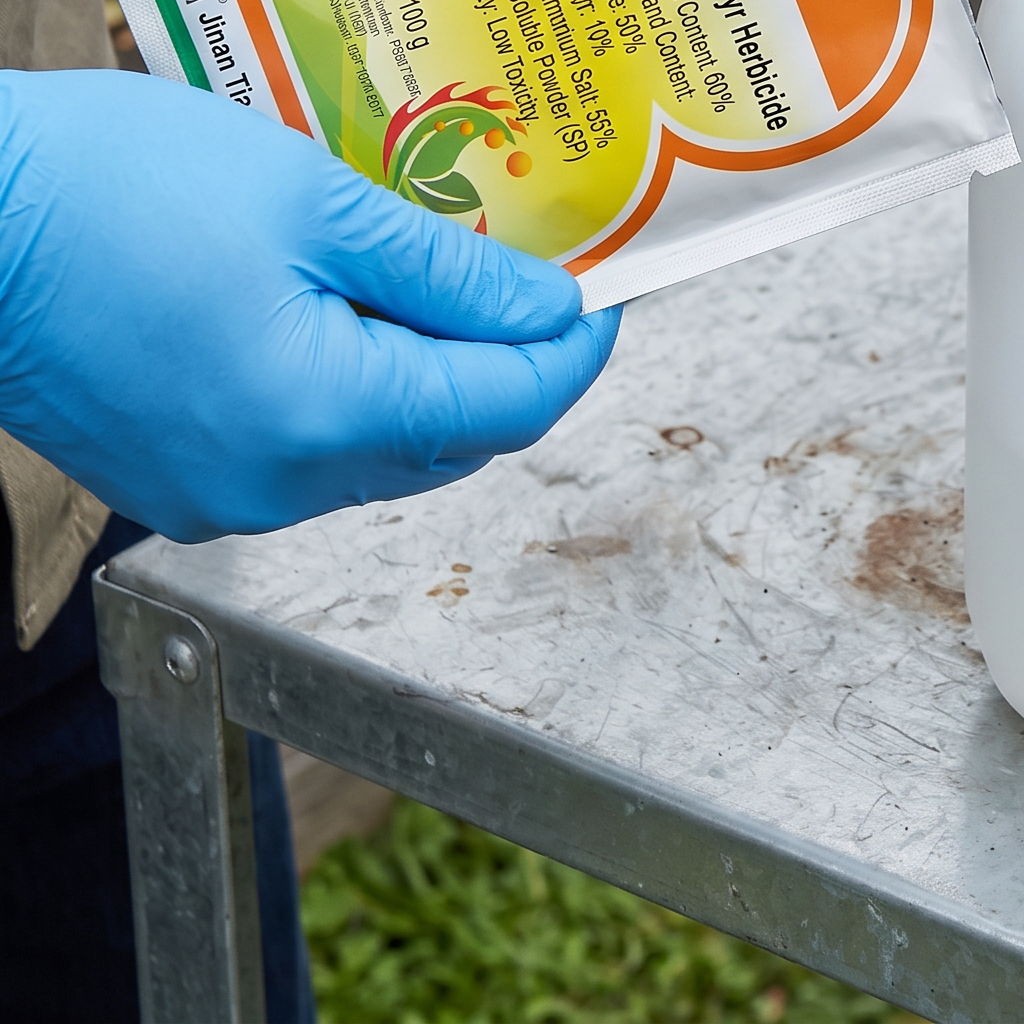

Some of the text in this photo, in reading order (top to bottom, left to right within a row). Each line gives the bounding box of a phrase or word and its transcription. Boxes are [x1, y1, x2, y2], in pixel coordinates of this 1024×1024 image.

[198, 13, 235, 72] Jinan
[405, 36, 430, 51] g
[585, 20, 615, 57] 10%
[615, 14, 647, 54] 50%
[486, 16, 514, 55] Low
[502, 55, 540, 126] Toxicity.
[570, 68, 599, 109] Salt:
[655, 31, 696, 103] Content:
[730, 21, 791, 131] Herbicide
[533, 53, 571, 120] Powder
[553, 123, 591, 162] (SP)
[704, 72, 735, 113] 60%
